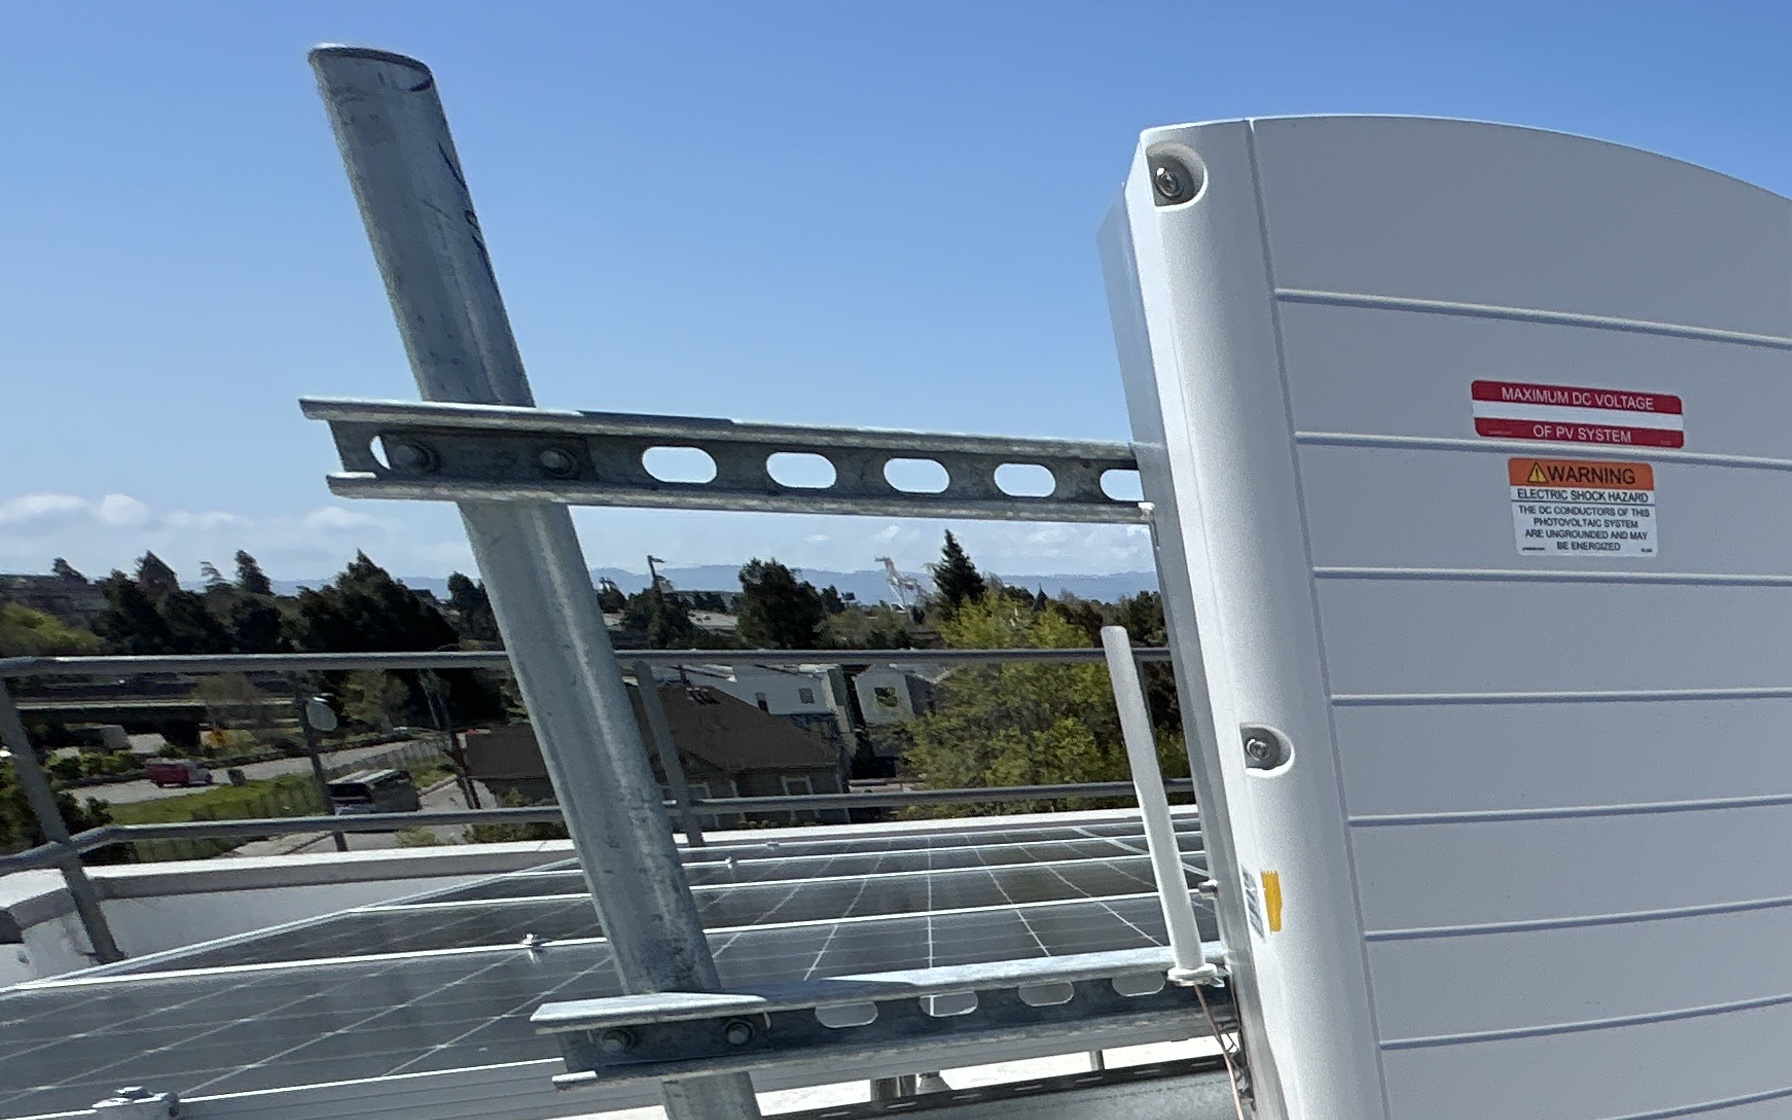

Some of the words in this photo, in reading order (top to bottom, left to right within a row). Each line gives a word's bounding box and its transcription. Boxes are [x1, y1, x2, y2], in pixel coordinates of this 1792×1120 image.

[1501, 387, 1569, 405] MAXIMUM
[1572, 392, 1592, 406] DC
[1594, 394, 1655, 411] VOLTAGE
[1533, 424, 1552, 438] OF
[1556, 426, 1574, 440] PV
[1577, 427, 1632, 443] SYSTEM
[1547, 465, 1636, 485] WARNING
[1517, 488, 1568, 500] ELECTRIC
[1570, 490, 1606, 501] SHOCK
[1608, 492, 1649, 503] HAZARD
[1518, 504, 1536, 515] THE
[1538, 506, 1552, 515] DC
[1553, 506, 1616, 516] CONDUCTORS
[1617, 508, 1629, 517] OF
[1631, 508, 1650, 518] THIS
[1533, 517, 1603, 528] PHOTOVOLTAIC
[1604, 519, 1638, 529] SYSTEM
[1525, 528, 1544, 538] ARE
[1545, 529, 1609, 540] UNGROUNDED
[1610, 530, 1628, 540] AND
[1629, 531, 1648, 541] MAY
[1556, 541, 1568, 550] BE
[1571, 541, 1621, 551] ENERGIZED
